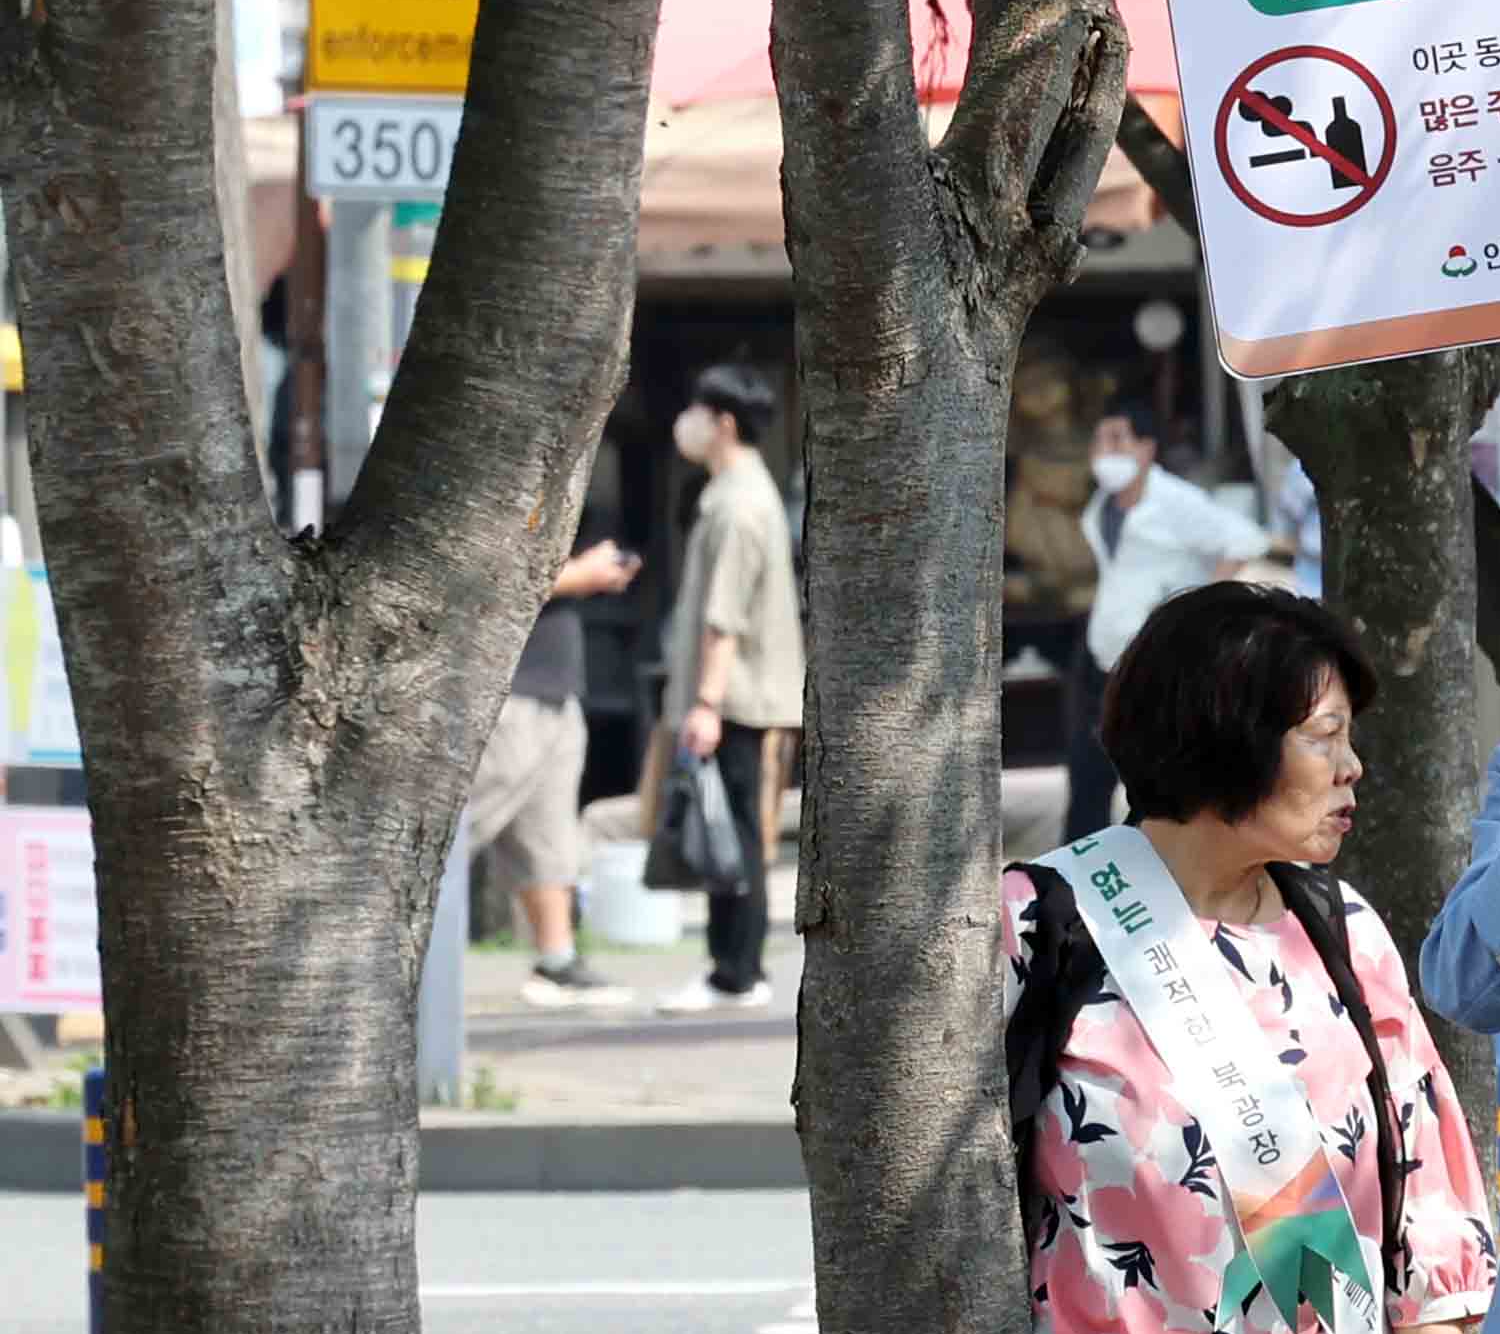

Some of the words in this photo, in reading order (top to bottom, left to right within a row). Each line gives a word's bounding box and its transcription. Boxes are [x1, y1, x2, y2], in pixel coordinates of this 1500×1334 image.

[1412, 42, 1467, 76] 이곳
[1420, 97, 1478, 134] 많은
[334, 120, 442, 180] 350
[1427, 154, 1486, 189] 음주
